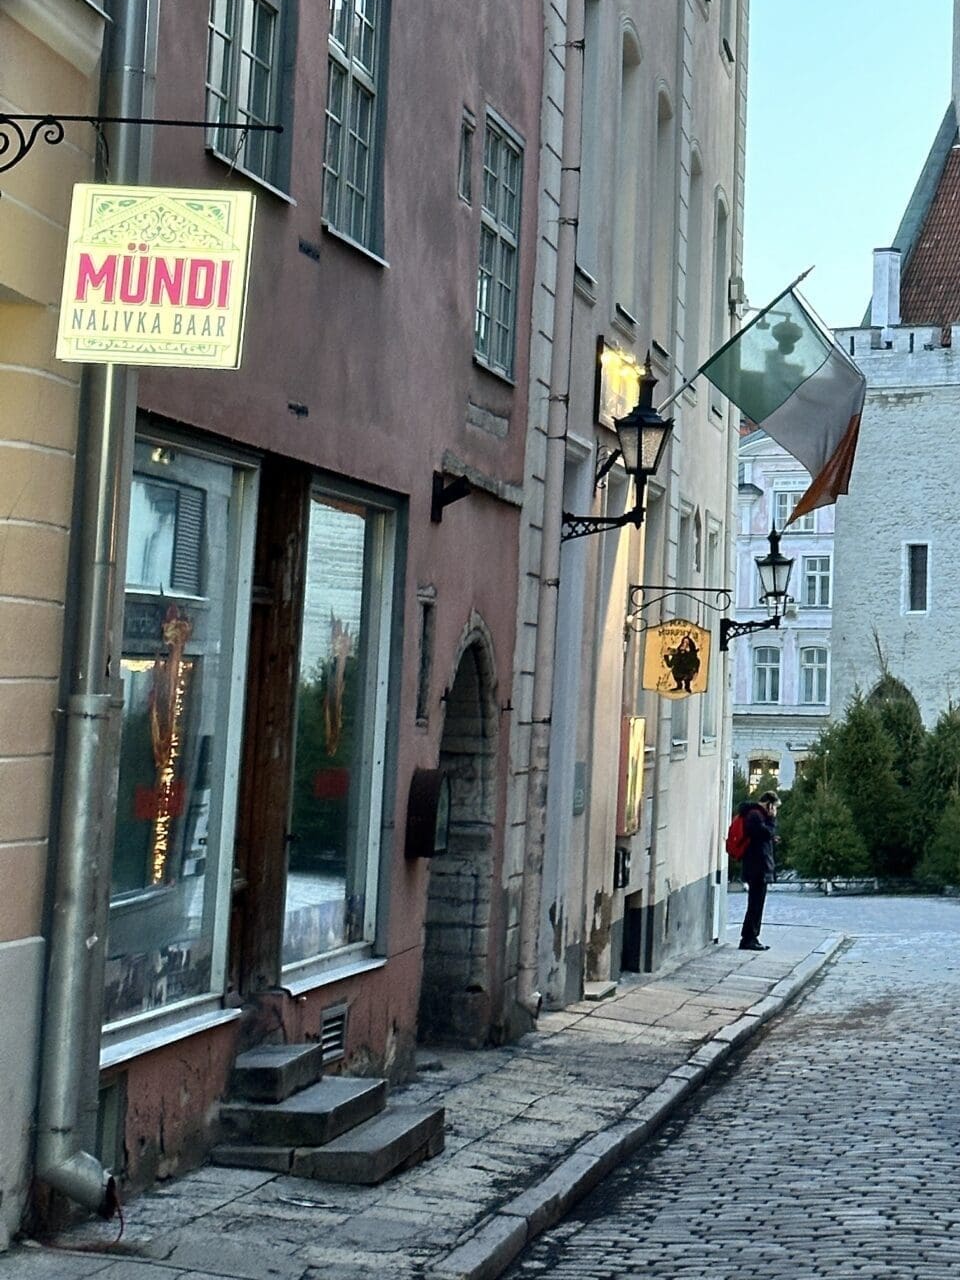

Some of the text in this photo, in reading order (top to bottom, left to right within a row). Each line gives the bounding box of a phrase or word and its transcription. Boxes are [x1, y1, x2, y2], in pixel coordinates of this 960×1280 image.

[75, 243, 233, 309] MÜNDI
[72, 309, 226, 337] NALIVKA BAAR
